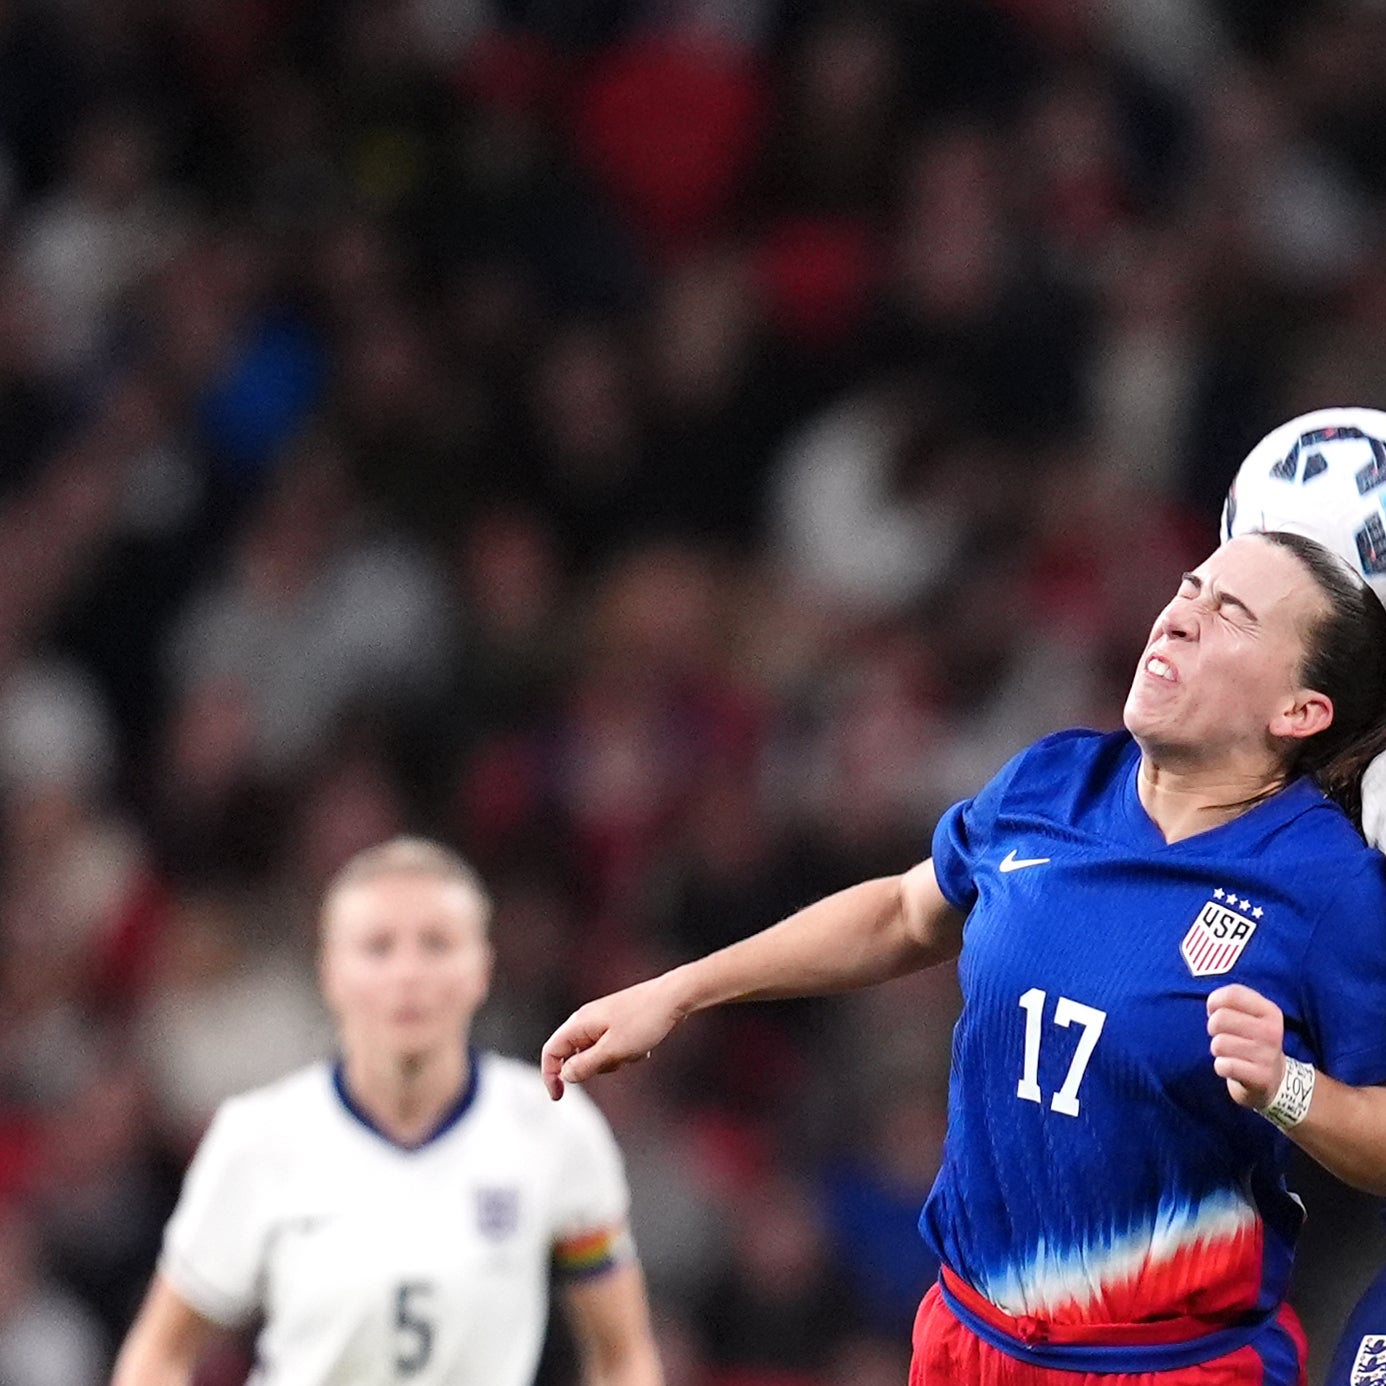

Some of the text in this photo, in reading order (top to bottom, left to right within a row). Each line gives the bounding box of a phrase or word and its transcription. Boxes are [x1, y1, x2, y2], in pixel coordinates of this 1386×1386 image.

[1203, 906, 1250, 940] USA
[1017, 987, 1107, 1117] 17
[394, 1276, 438, 1379] 5
